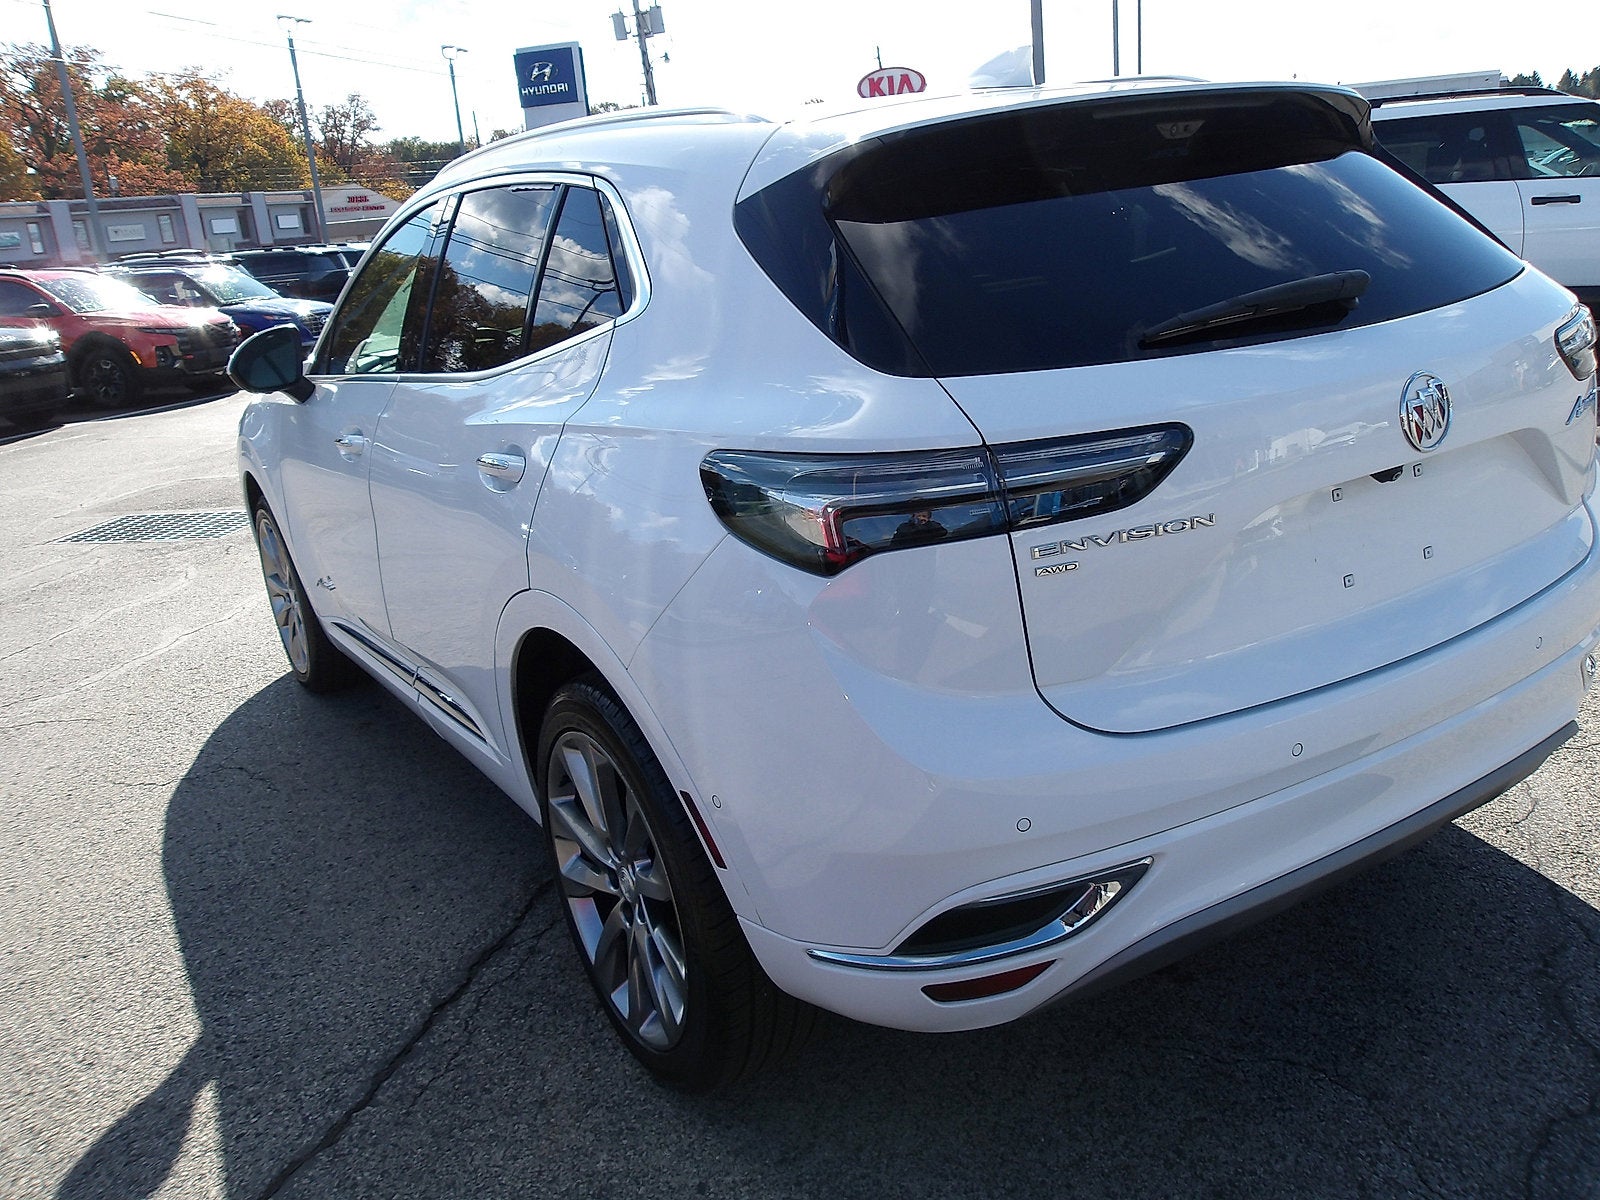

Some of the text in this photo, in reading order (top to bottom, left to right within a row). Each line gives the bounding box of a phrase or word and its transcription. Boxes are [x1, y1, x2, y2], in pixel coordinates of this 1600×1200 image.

[521, 83, 568, 96] HYUNDAI
[868, 74, 914, 97] KIA
[1030, 513, 1216, 560] ENVISION
[1036, 562, 1079, 576] AWD
